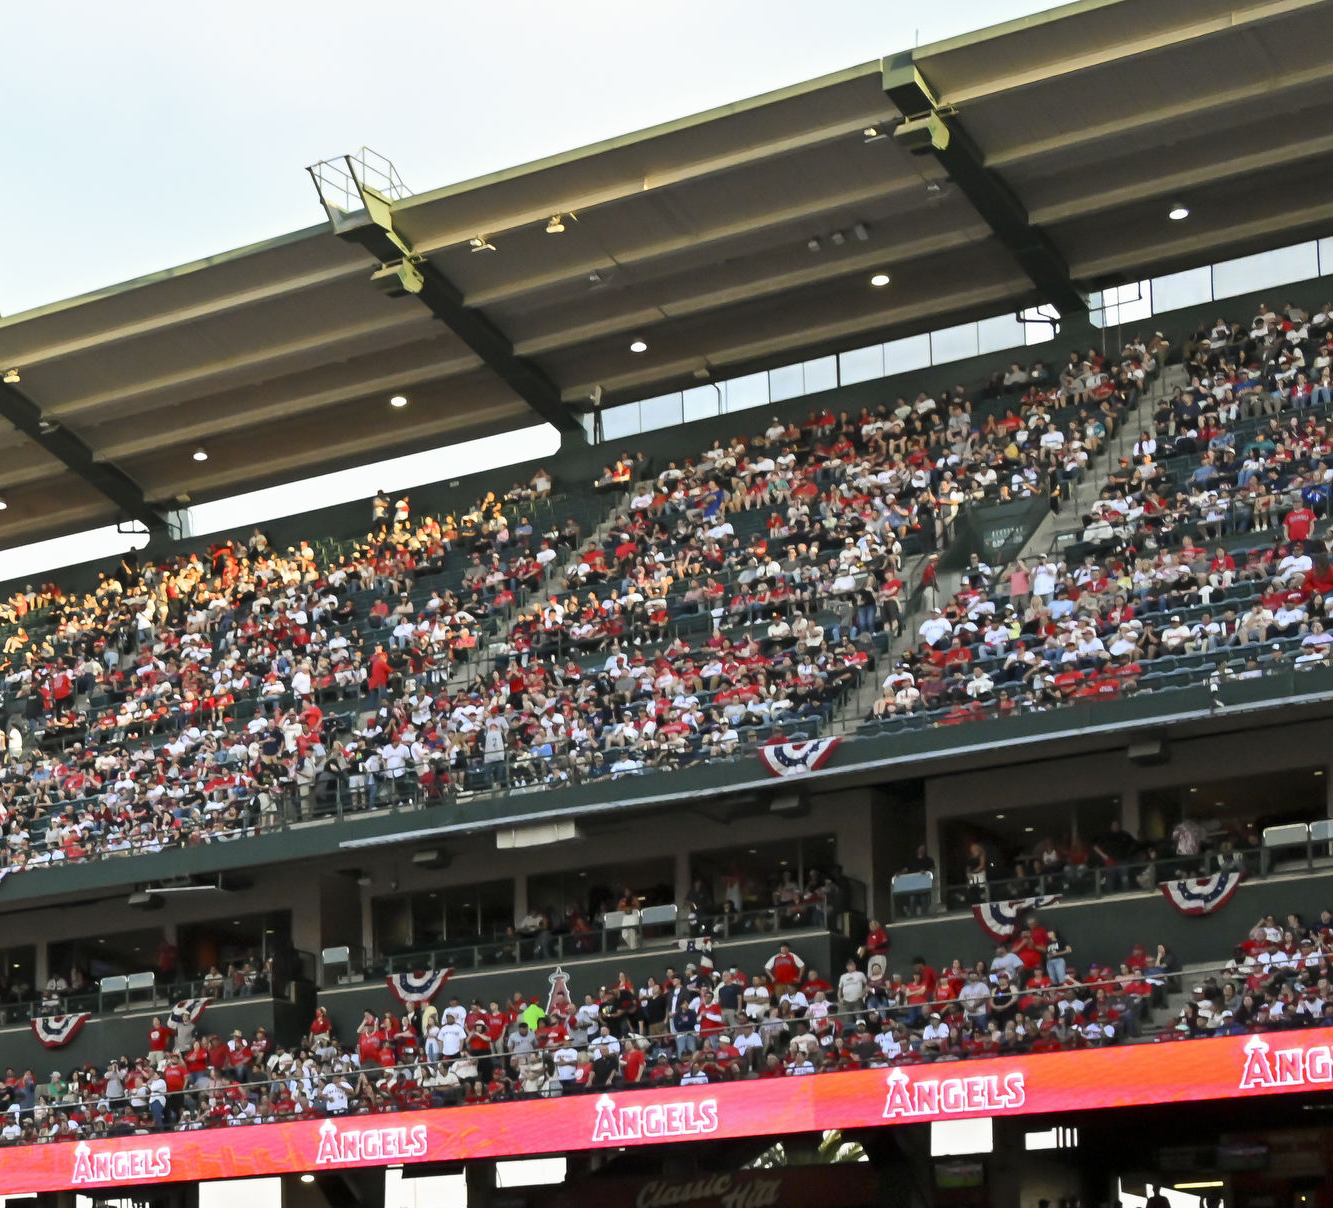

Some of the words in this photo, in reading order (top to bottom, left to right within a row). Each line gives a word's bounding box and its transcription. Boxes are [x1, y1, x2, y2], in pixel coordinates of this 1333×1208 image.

[883, 1066, 1025, 1118] ANGELS
[317, 1118, 427, 1164] ANGELS
[592, 1093, 718, 1142] ANGELS
[72, 1141, 171, 1183] ANGELS
